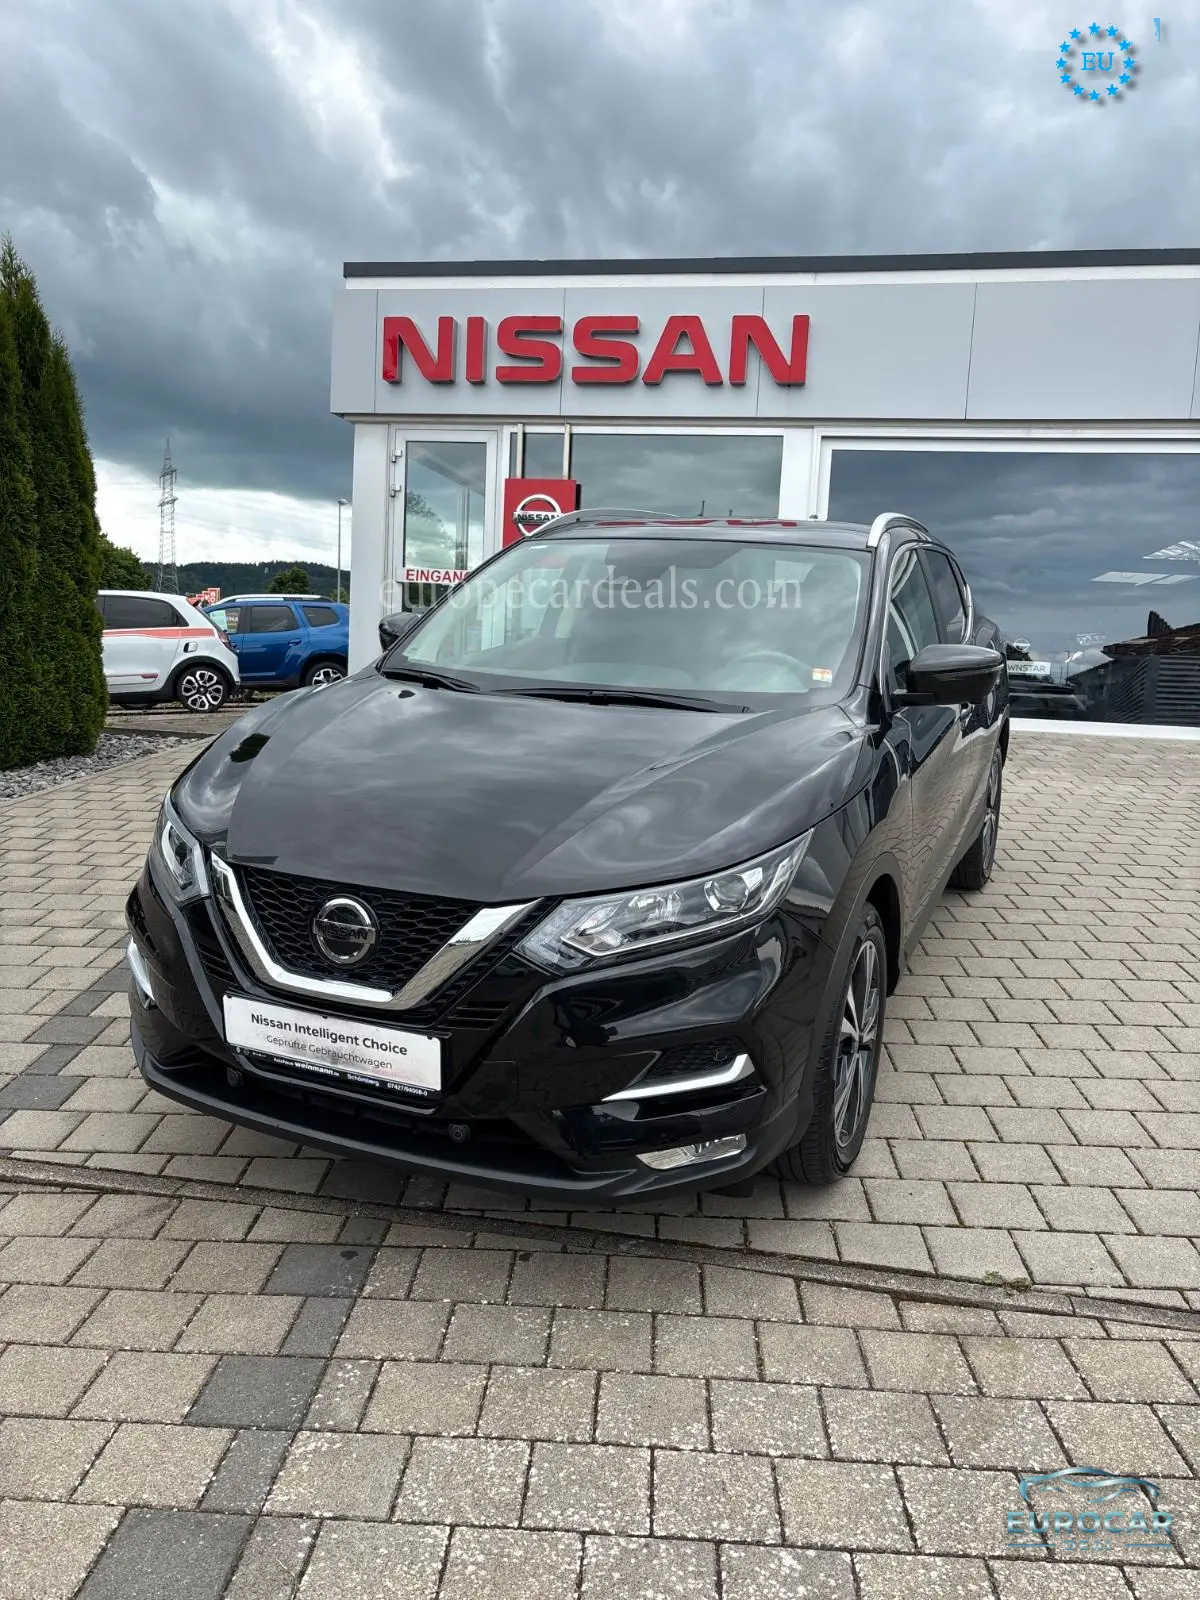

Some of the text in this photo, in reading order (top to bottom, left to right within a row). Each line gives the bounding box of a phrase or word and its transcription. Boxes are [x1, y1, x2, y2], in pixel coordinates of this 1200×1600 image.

[382, 314, 810, 386] NISSAN
[517, 512, 561, 522] NISSAN
[318, 922, 369, 940] NISSAN
[251, 1013, 408, 1056] Nissan Intelligent Choice
[266, 1034, 393, 1070] Geprüfte Gebrauchtwagen
